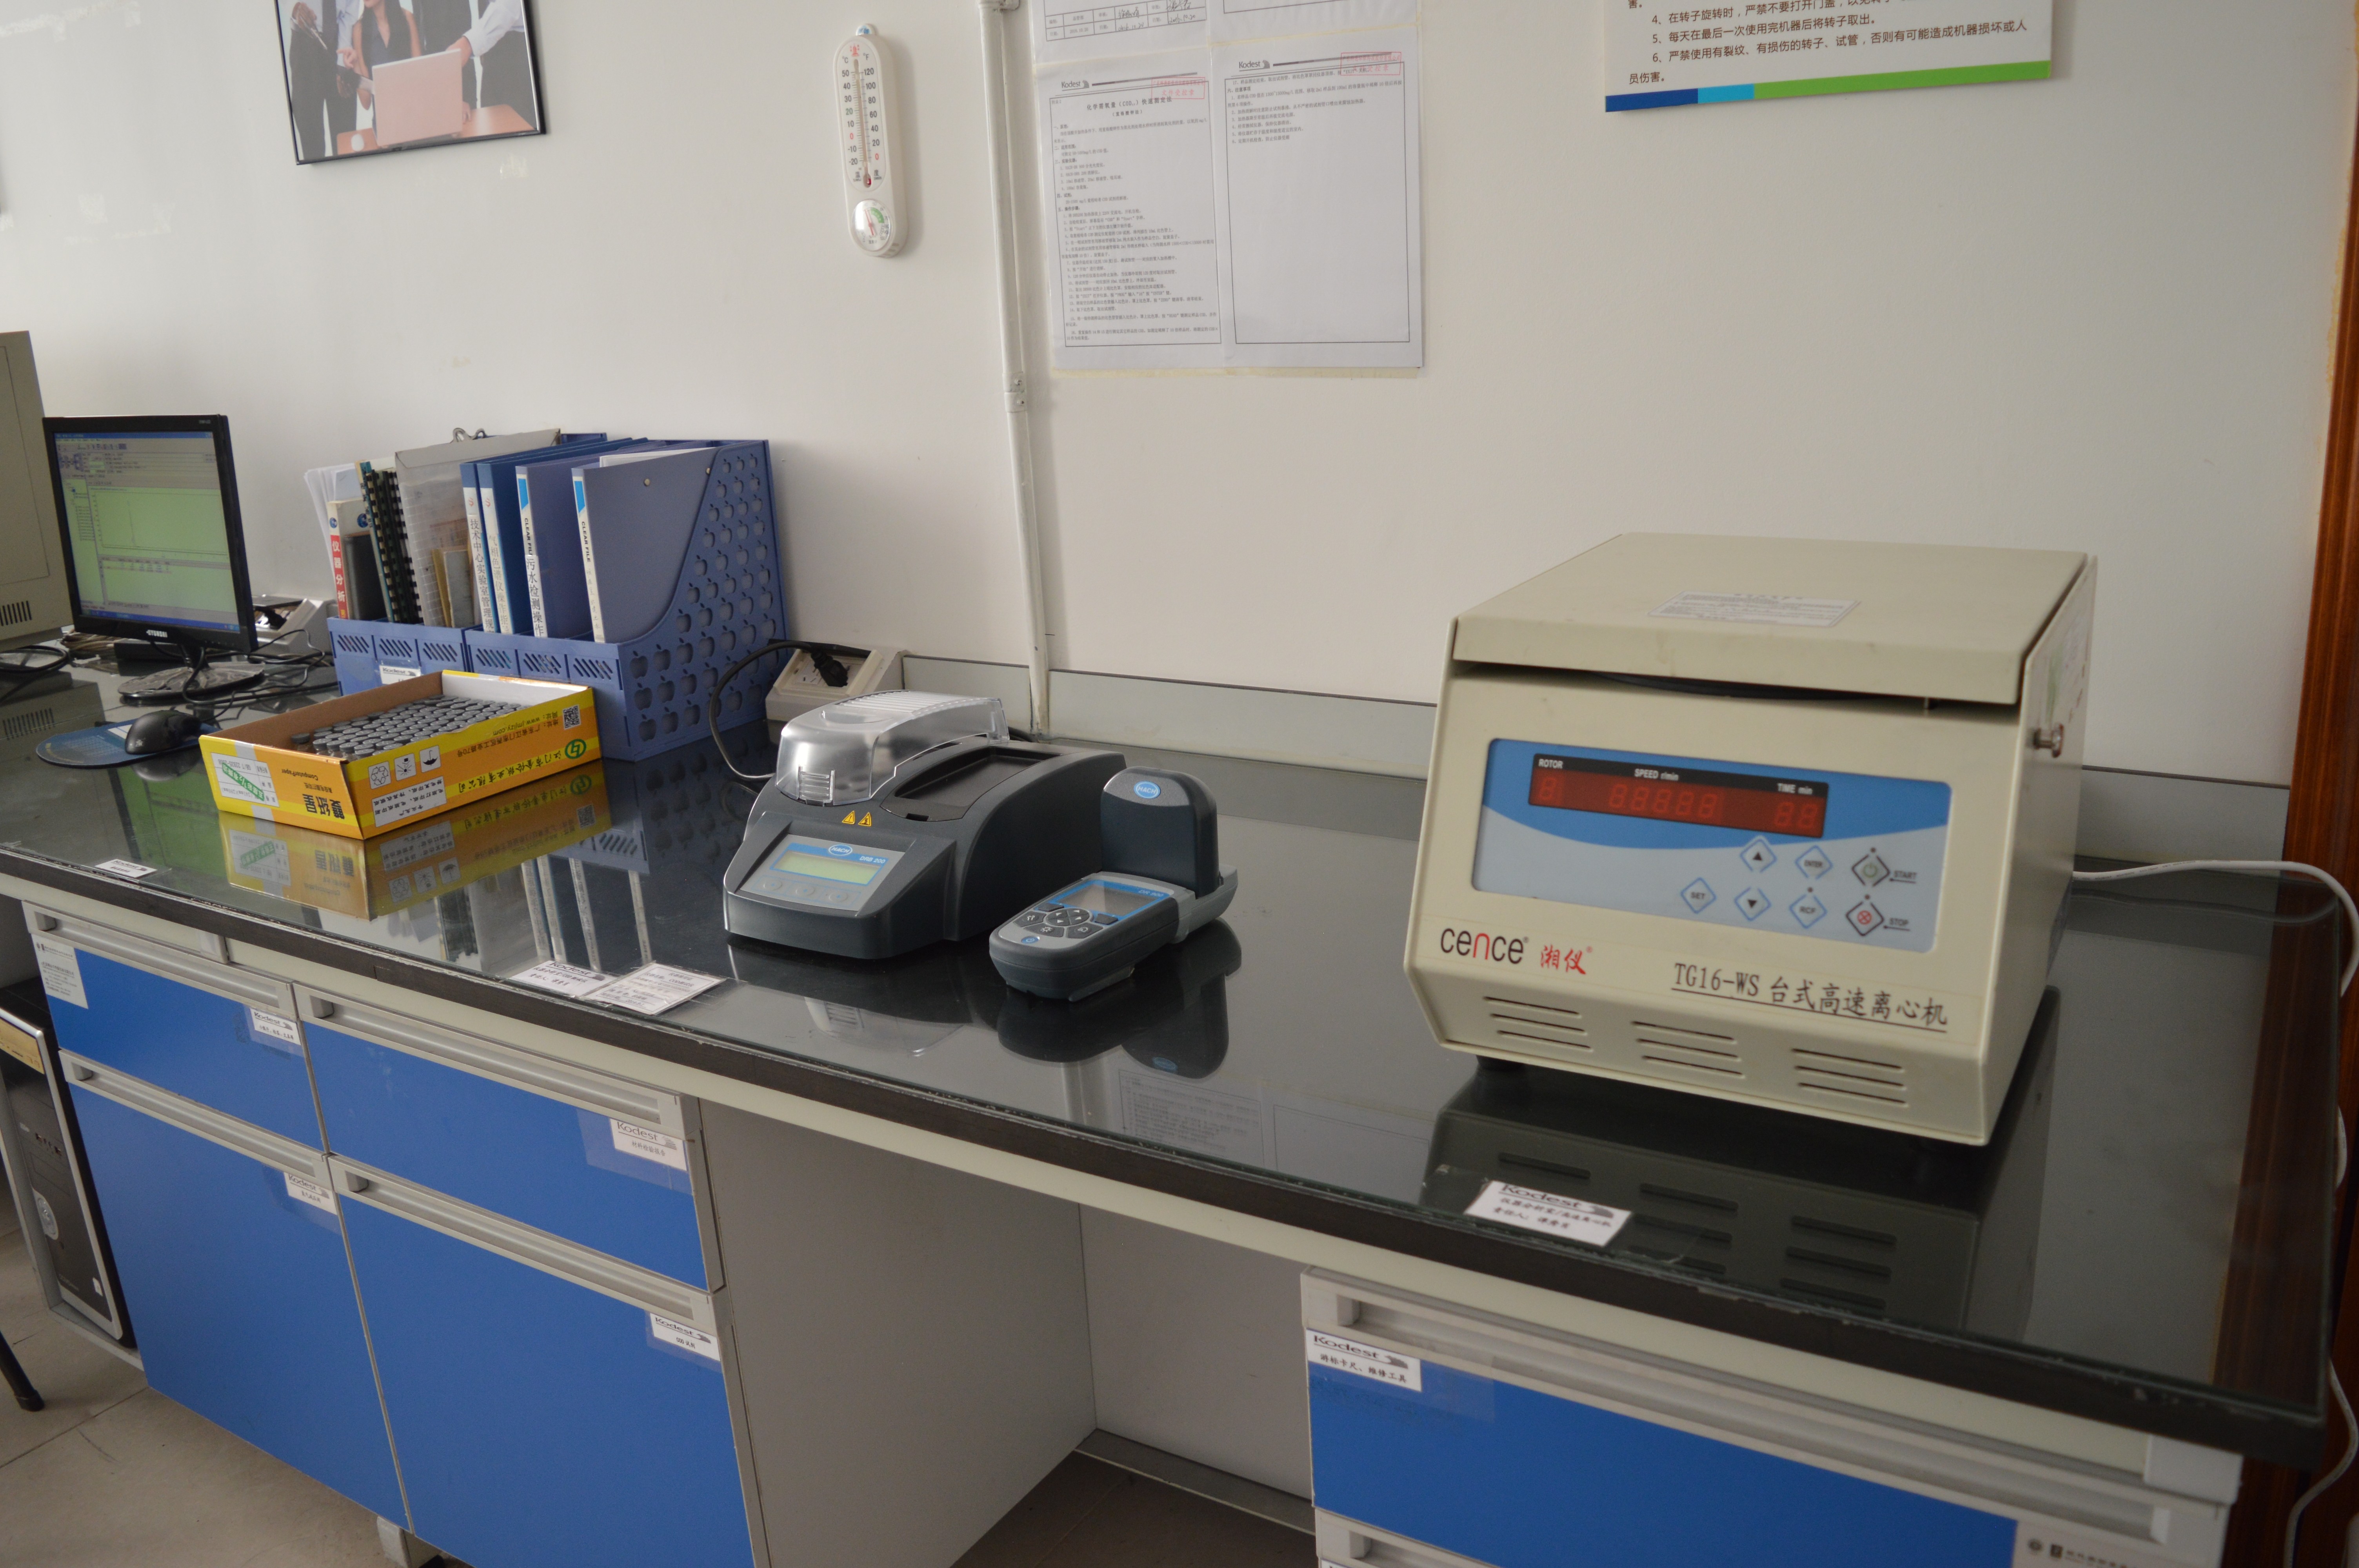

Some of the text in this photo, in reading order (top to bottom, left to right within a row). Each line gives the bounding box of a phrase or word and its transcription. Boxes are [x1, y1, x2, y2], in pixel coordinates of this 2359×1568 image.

[1238, 60, 1260, 69] Kodest
[1629, 72, 1665, 84] 员伤害。
[332, 541, 345, 602] 仪器分析
[526, 558, 544, 637] 污水检测操作
[458, 750, 562, 793] 江门市金伦纸业有限公司
[1538, 758, 1563, 769] ROTOR
[282, 768, 318, 781] ComputerPaper
[1634, 768, 1659, 780] SPEED
[1777, 783, 1813, 795] TIME min
[399, 805, 423, 816] 专业生产
[1893, 870, 1917, 879] START
[1690, 891, 1706, 900] SET
[1799, 906, 1816, 915] RCF
[1888, 917, 1909, 927] STOP
[1440, 927, 1525, 965] cence
[1540, 944, 1588, 976] 湘仪
[549, 961, 591, 976] Kodest
[1673, 962, 1949, 1027] TG16-WS 台式高速离心机
[254, 1011, 281, 1025] Kodest
[617, 1121, 658, 1142] Kodest
[632, 1140, 666, 1157] 材料检验报告
[288, 1174, 316, 1191] Kodest
[1500, 1183, 1582, 1208] Kodest
[655, 1317, 693, 1336] Kodest
[1314, 1335, 1379, 1359] Kodest
[1320, 1354, 1407, 1383] 游标卡尺、维修工具
